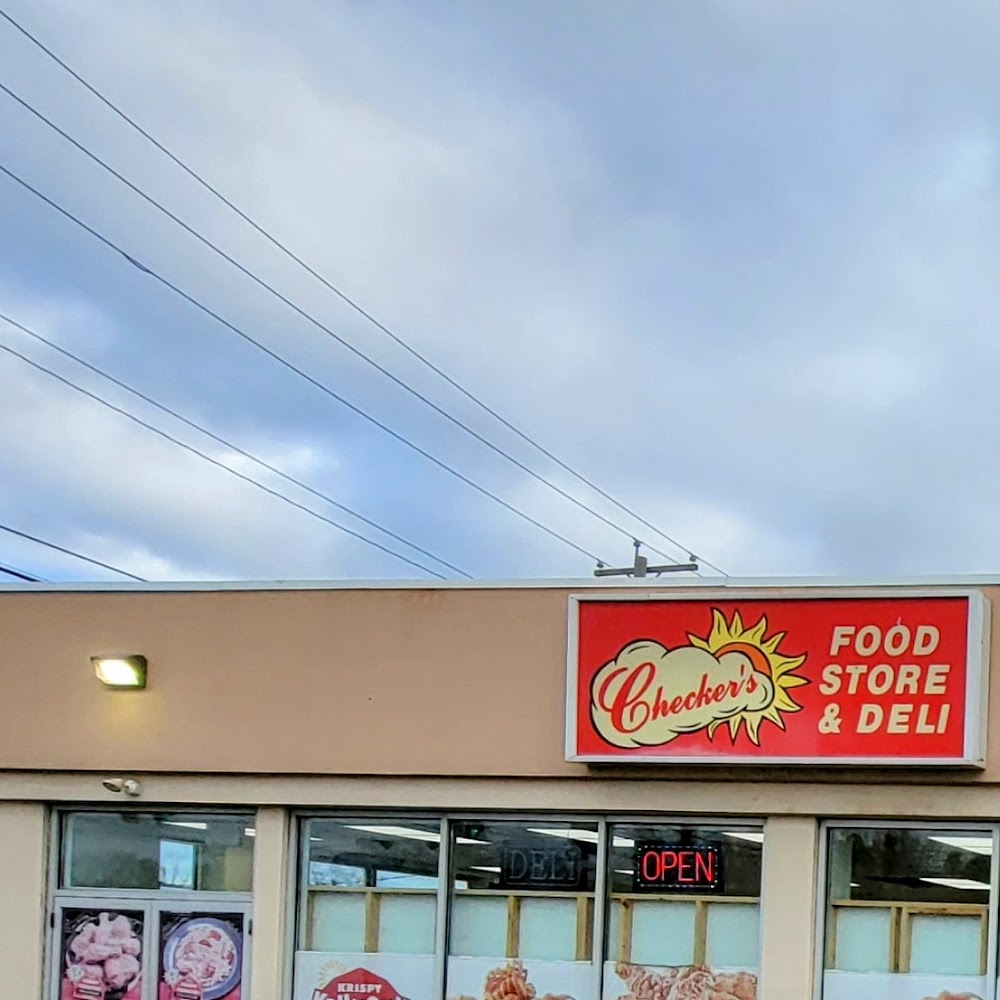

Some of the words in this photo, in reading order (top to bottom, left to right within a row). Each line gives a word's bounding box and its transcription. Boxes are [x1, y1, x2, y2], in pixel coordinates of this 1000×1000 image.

[830, 625, 940, 657] FOOD
[818, 664, 951, 696] STORE
[598, 661, 758, 734] Checker's
[818, 703, 843, 735] &
[855, 703, 951, 735] DELI
[508, 850, 576, 881] DELI
[642, 850, 713, 882] OPEN
[337, 983, 382, 993] KRISPY
